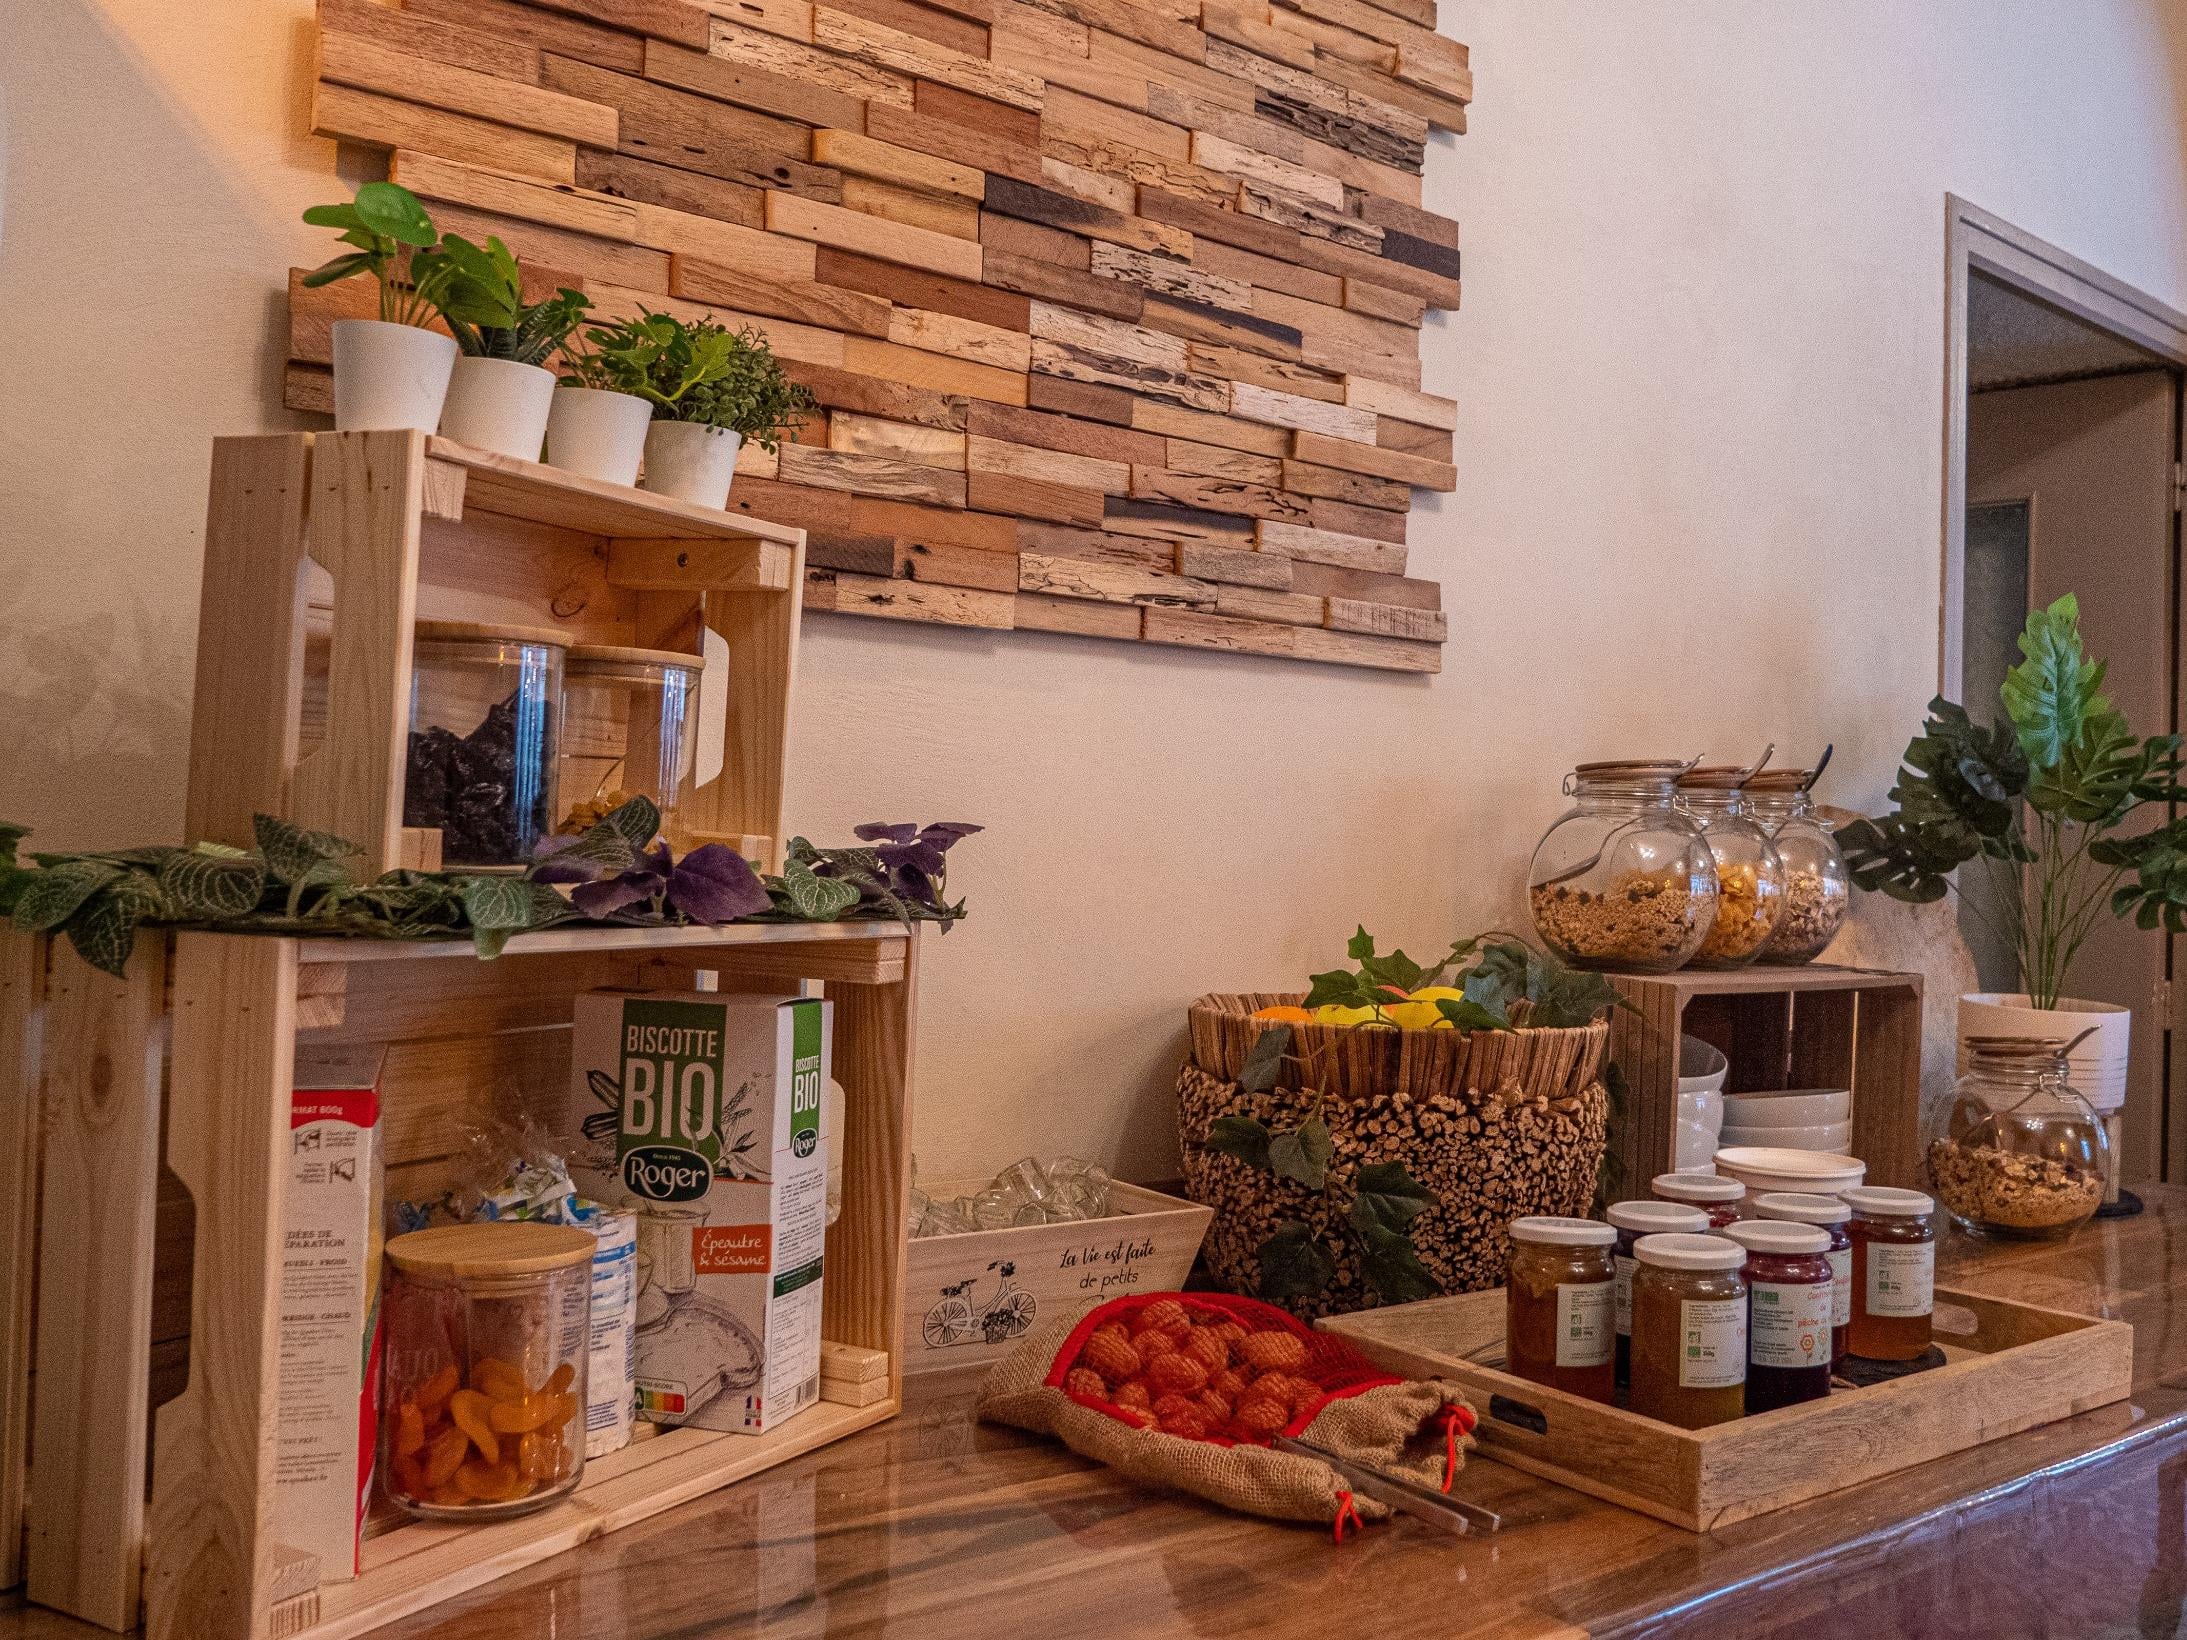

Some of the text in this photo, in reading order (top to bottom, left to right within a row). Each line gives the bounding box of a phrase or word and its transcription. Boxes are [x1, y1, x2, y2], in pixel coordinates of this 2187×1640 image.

[627, 1024, 718, 1058] BISCOTTE
[795, 1054, 820, 1073] BISCOTTE
[622, 1057, 716, 1142] BIO
[794, 1070, 819, 1114] BIO
[794, 1136, 816, 1157] Roger
[630, 1156, 706, 1199] Roger
[700, 1227, 763, 1252] Épeautre
[1059, 1238, 1155, 1269] La Vie est faite
[699, 1249, 767, 1267] & sésame
[1079, 1267, 1139, 1293] de petits
